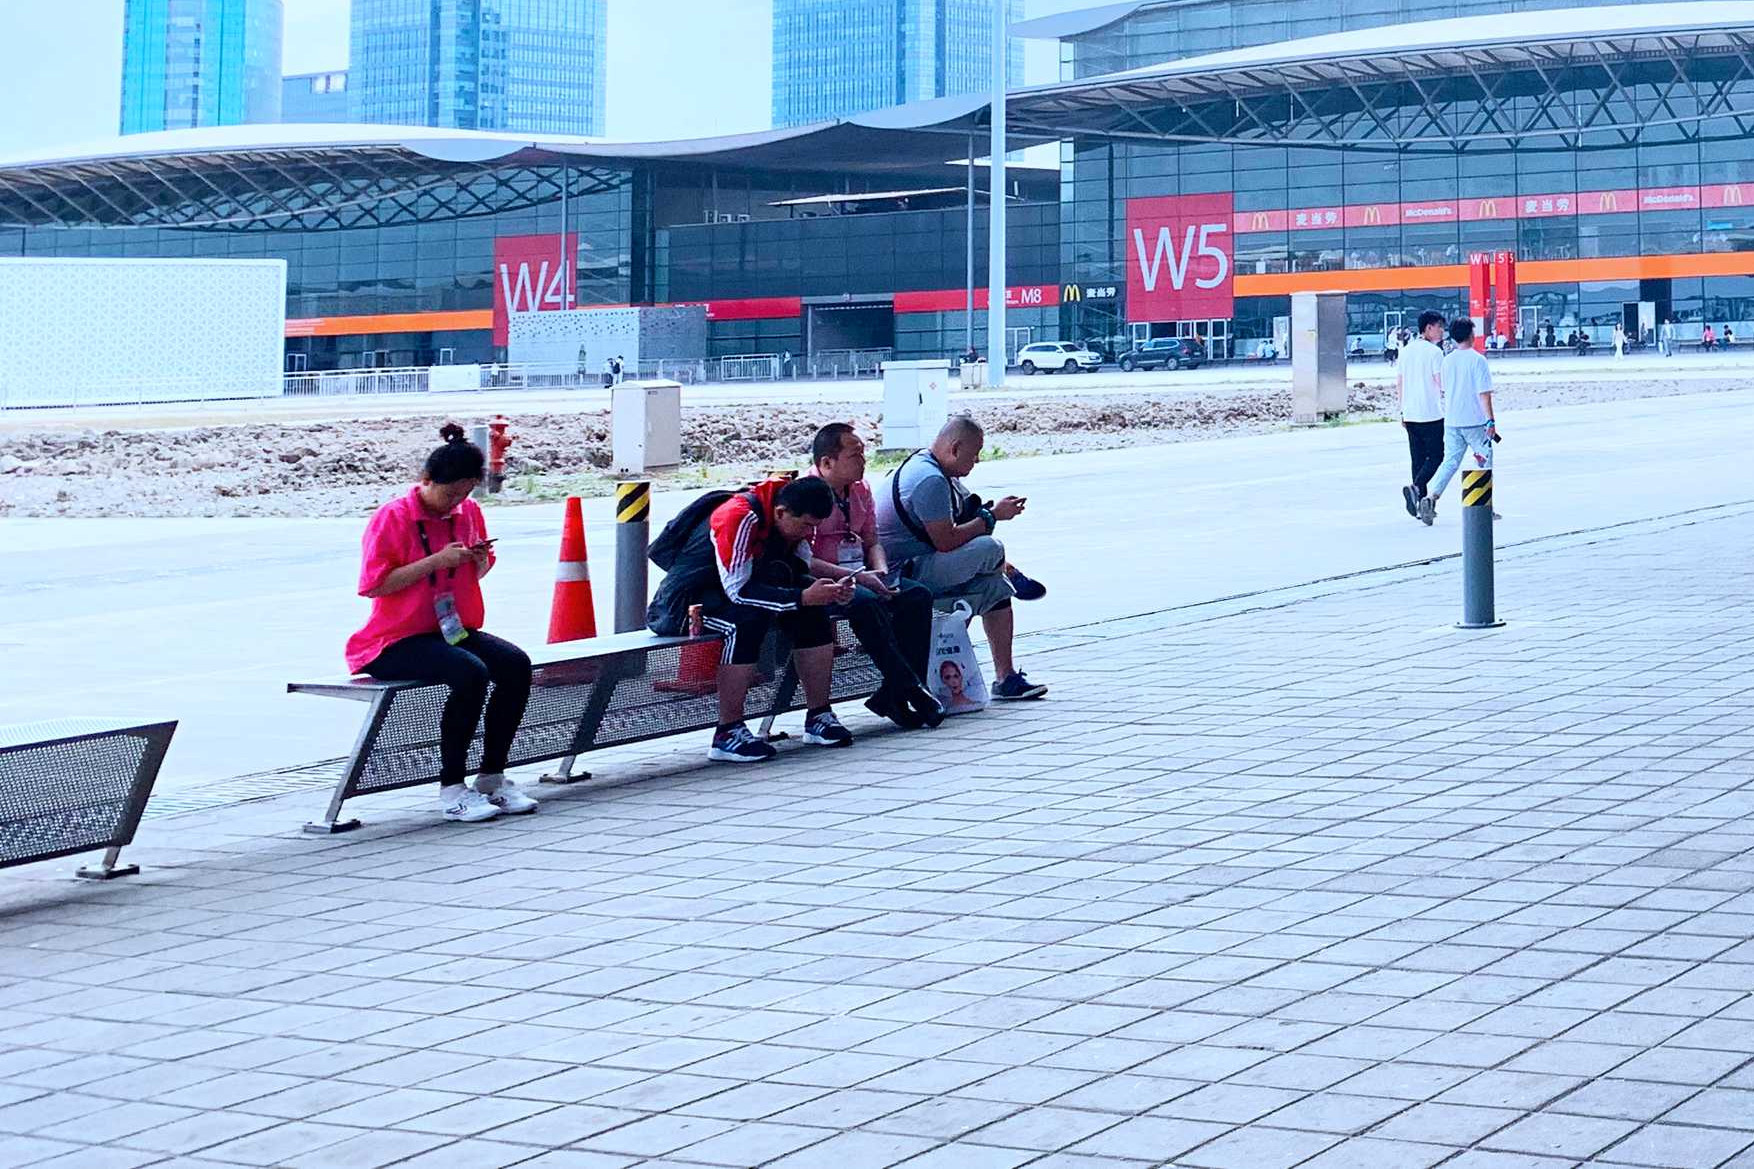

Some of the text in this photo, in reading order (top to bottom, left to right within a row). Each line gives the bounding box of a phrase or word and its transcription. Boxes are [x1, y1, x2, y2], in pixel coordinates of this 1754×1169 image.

[1524, 197, 1570, 213] 麦当劳
[1295, 211, 1338, 226] 麦当劳
[1132, 223, 1228, 292] W5
[500, 261, 575, 313] W4
[1086, 287, 1116, 298] 麦当劳
[1021, 288, 1041, 304] M8
